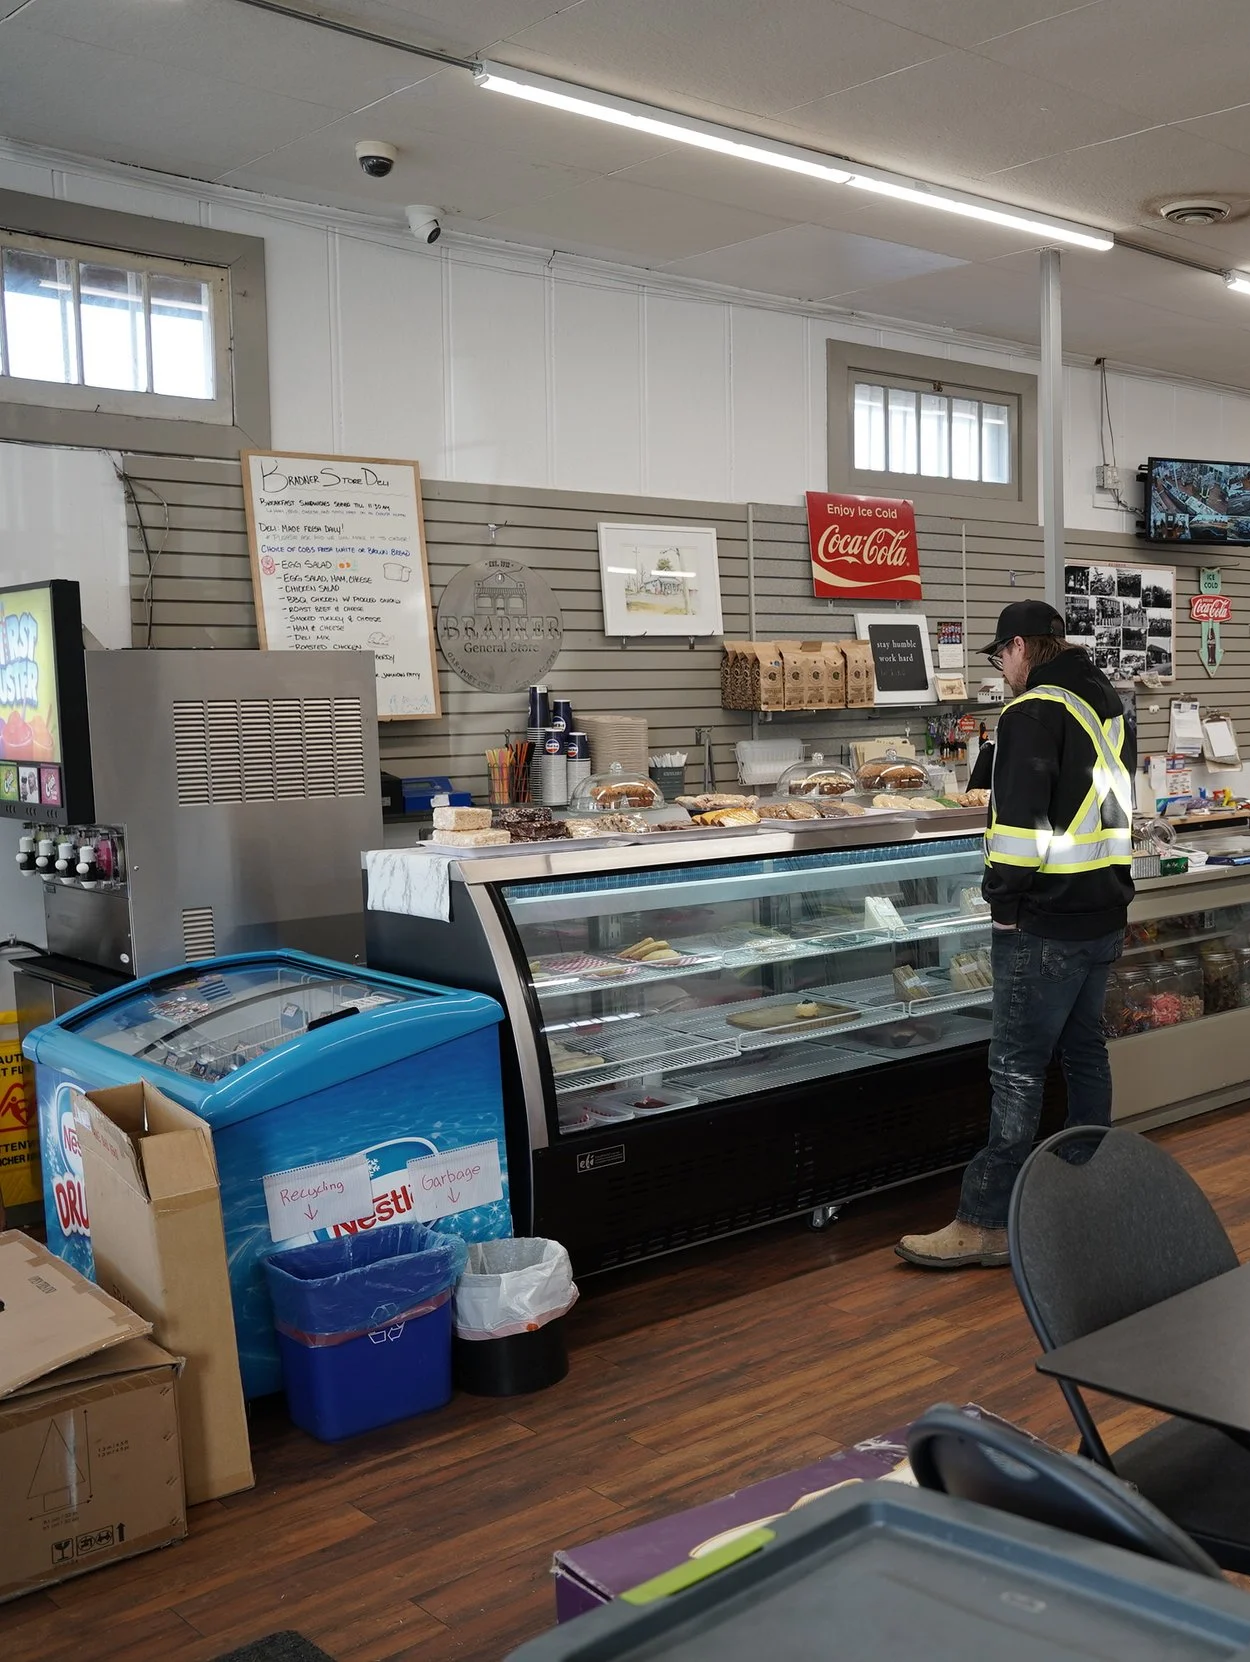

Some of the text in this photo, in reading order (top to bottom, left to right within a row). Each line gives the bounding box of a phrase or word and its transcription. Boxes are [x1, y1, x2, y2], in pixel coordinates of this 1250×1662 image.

[827, 503, 897, 519] Enjoy Ice Cold
[818, 524, 910, 566] Coca-Cola
[282, 560, 332, 569] EGG SALAD
[284, 574, 302, 582] EGG
[440, 616, 561, 640] BRADNER
[464, 642, 539, 653] General Store
[877, 640, 916, 650] stay humble
[879, 654, 914, 662] work hard
[421, 1164, 481, 1191] Garbage
[280, 1181, 345, 1207] Recycling
